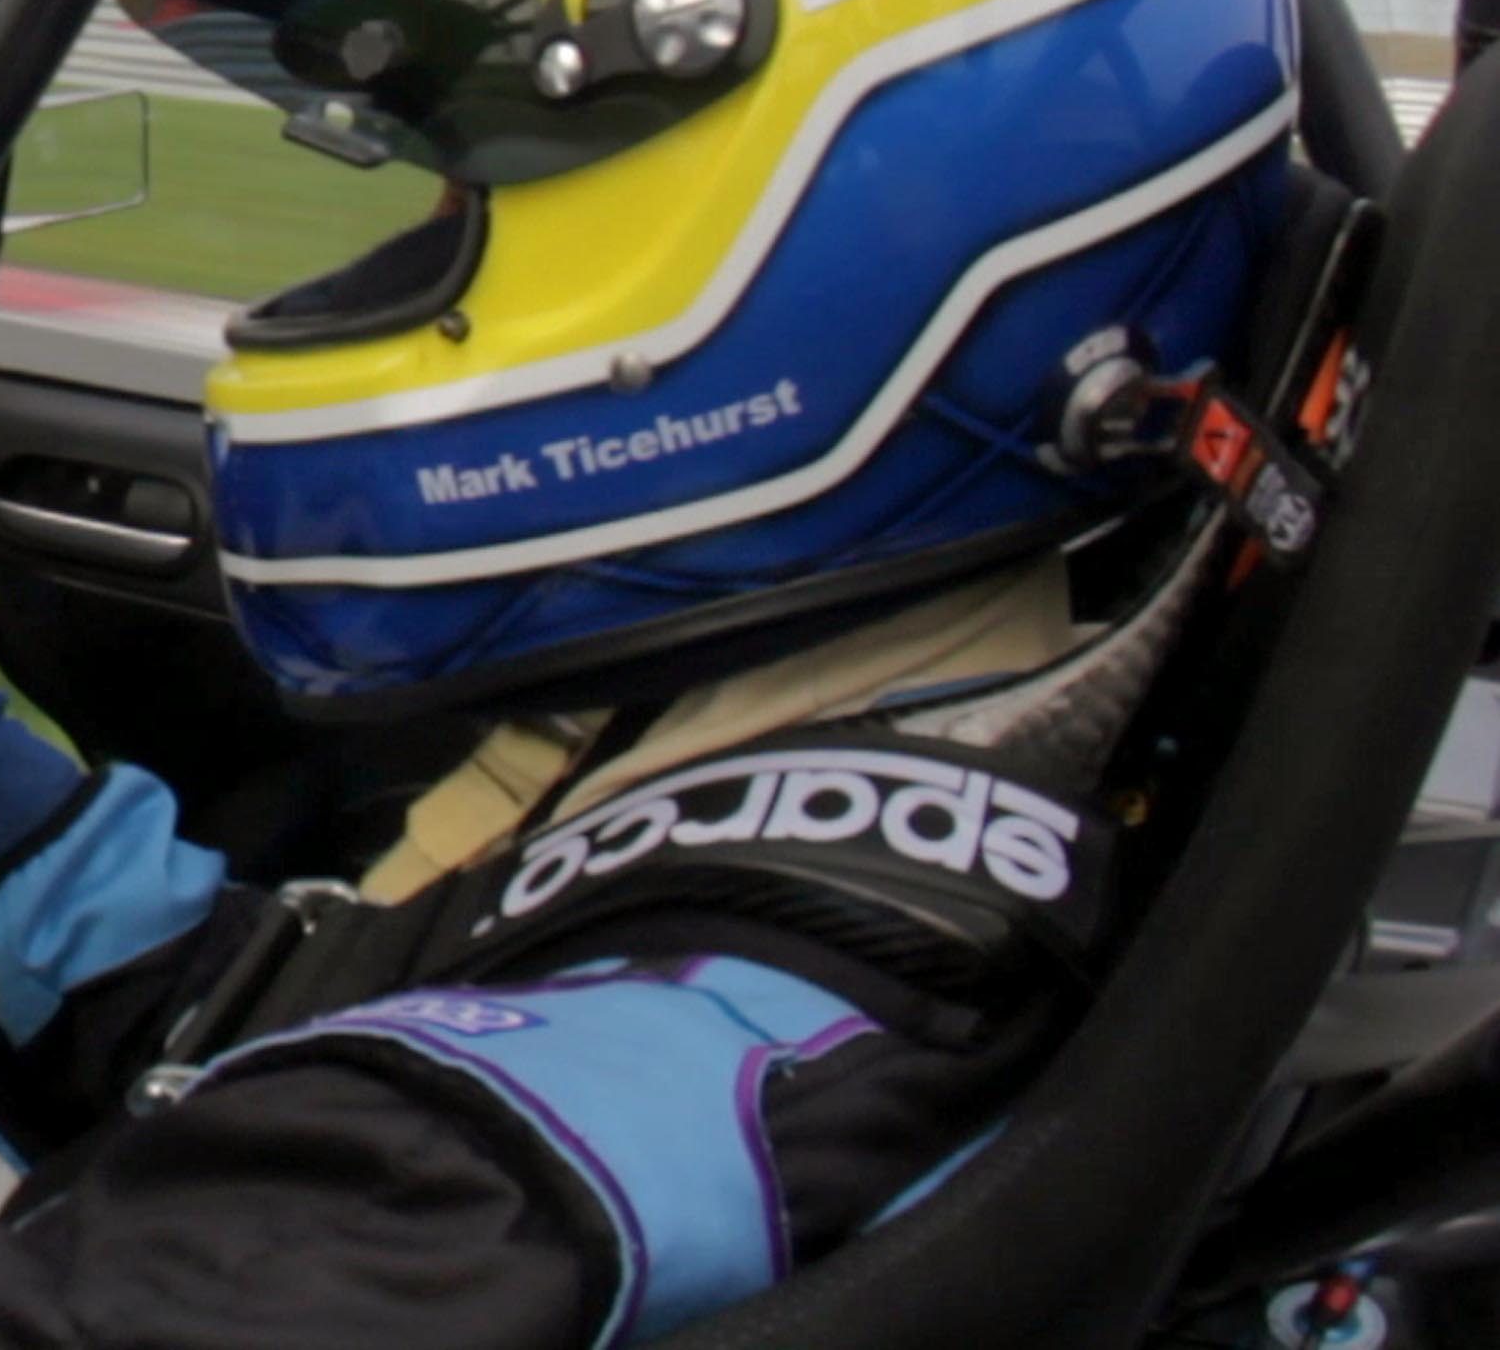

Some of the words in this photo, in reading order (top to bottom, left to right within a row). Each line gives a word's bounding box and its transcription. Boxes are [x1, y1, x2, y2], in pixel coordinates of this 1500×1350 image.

[416, 461, 536, 506] Mark
[542, 379, 801, 482] Ticehurst
[500, 748, 1080, 918] sparco
